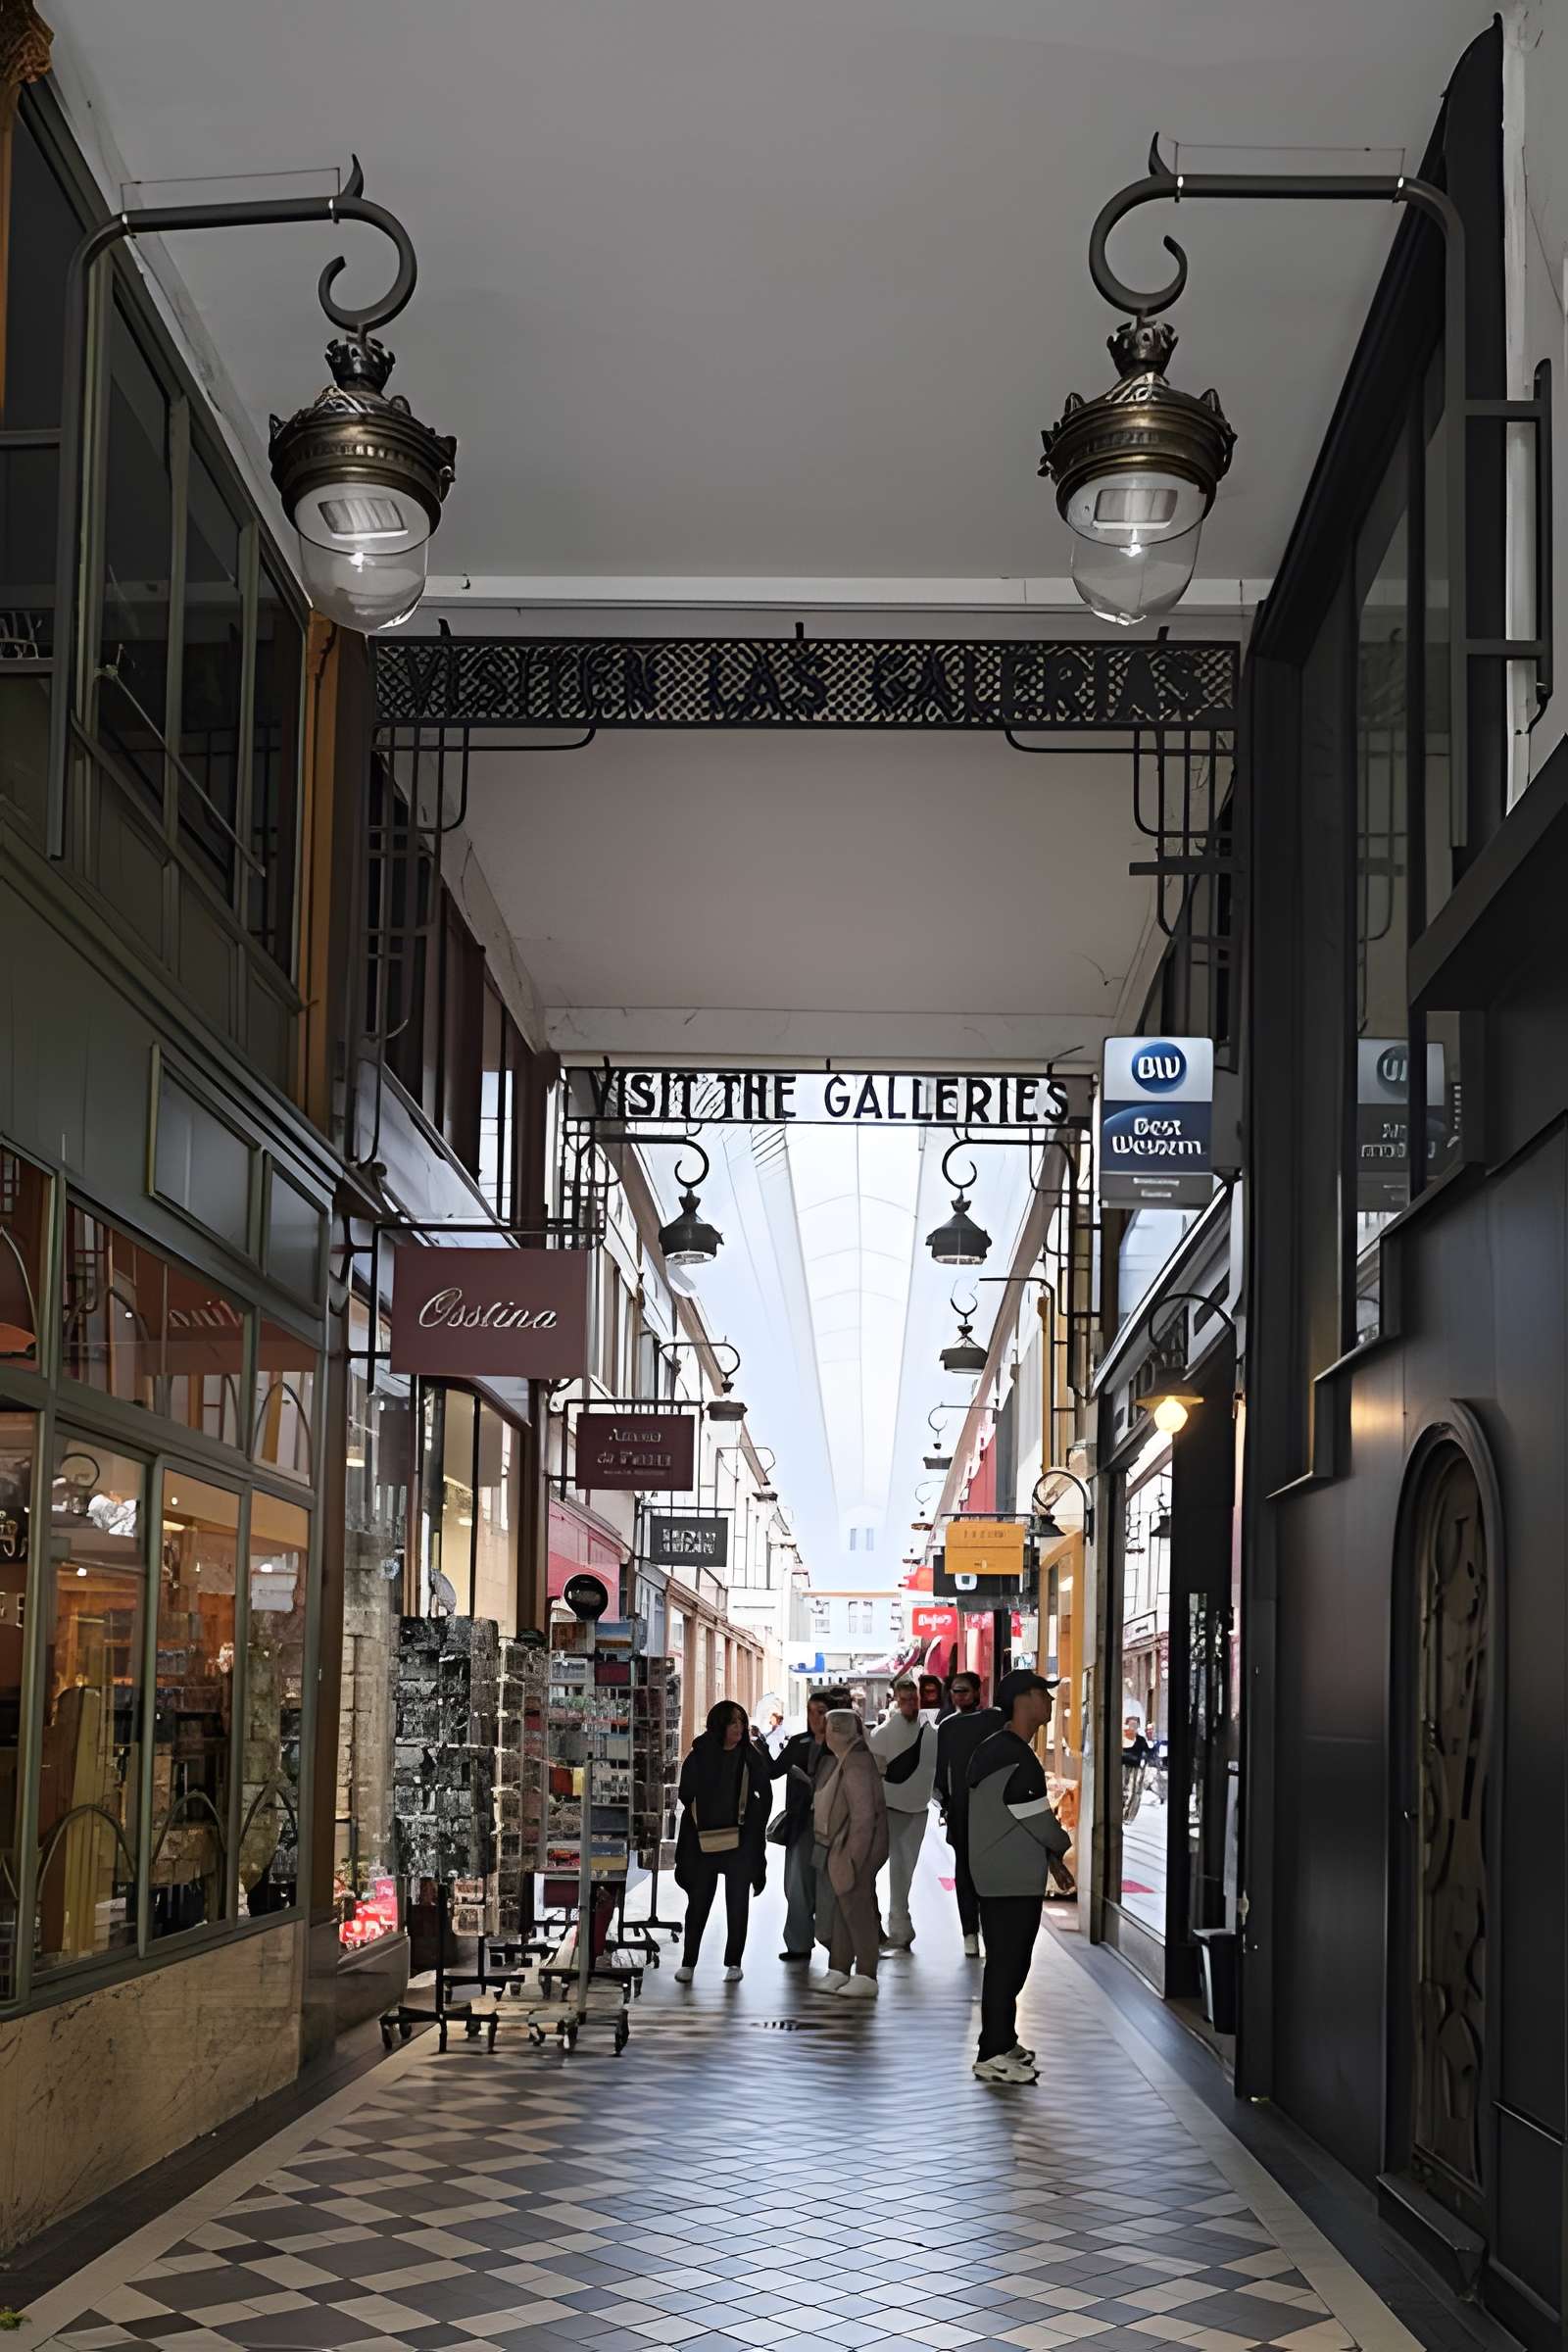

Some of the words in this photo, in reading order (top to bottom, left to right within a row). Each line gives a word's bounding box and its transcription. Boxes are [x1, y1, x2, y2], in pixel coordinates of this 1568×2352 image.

[590, 1070, 698, 1117] VISIT
[716, 1074, 797, 1119] THE
[824, 1075, 1069, 1122] GALLERIES
